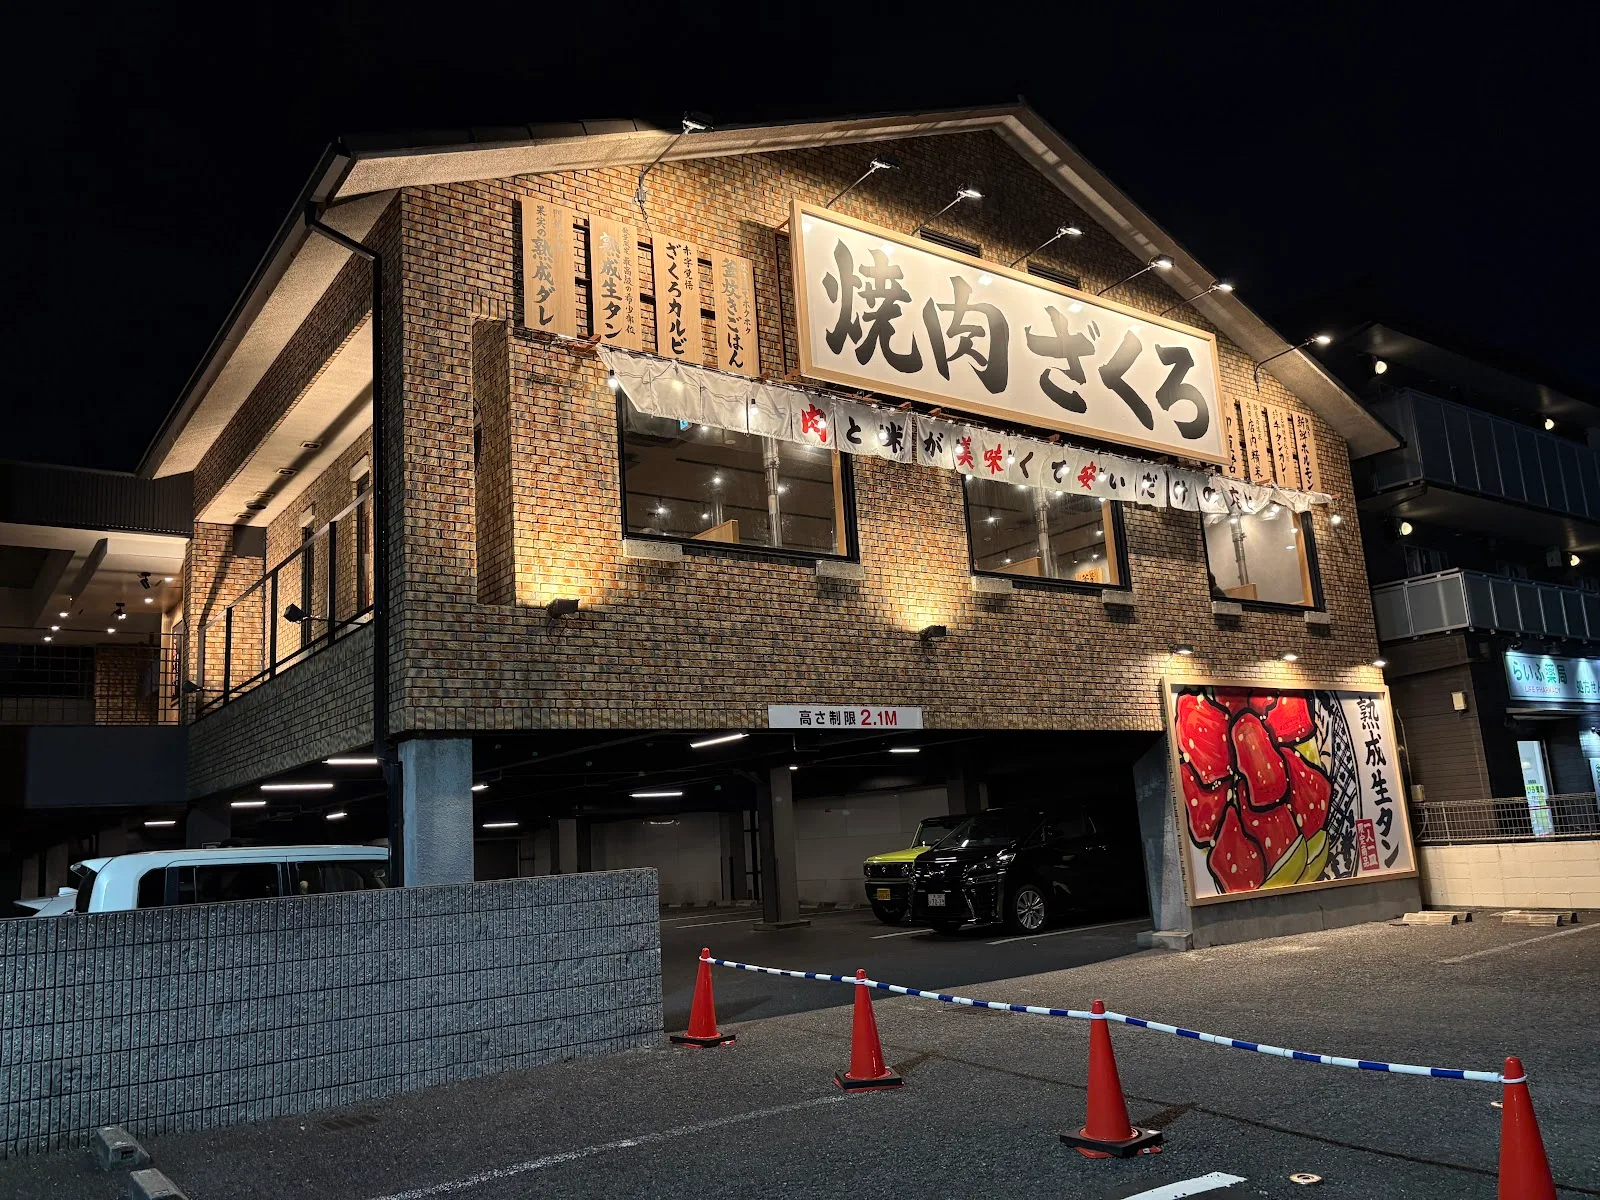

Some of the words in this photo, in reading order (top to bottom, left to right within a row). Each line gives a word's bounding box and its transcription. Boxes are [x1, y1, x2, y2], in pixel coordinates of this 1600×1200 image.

[531, 205, 555, 326] 果実の熟成ダレ
[599, 231, 623, 339] 熟成生タン
[666, 242, 688, 355] ざくろカルビ
[682, 245, 694, 291] 赤字覚悟
[721, 257, 744, 368] 釜炊きごはん
[822, 238, 1209, 439] 焼肉ざくろ
[1296, 414, 1315, 491] 新鮮ホルモン
[1512, 661, 1568, 684] らいふ薬局
[1356, 695, 1400, 868] 熟成生タン
